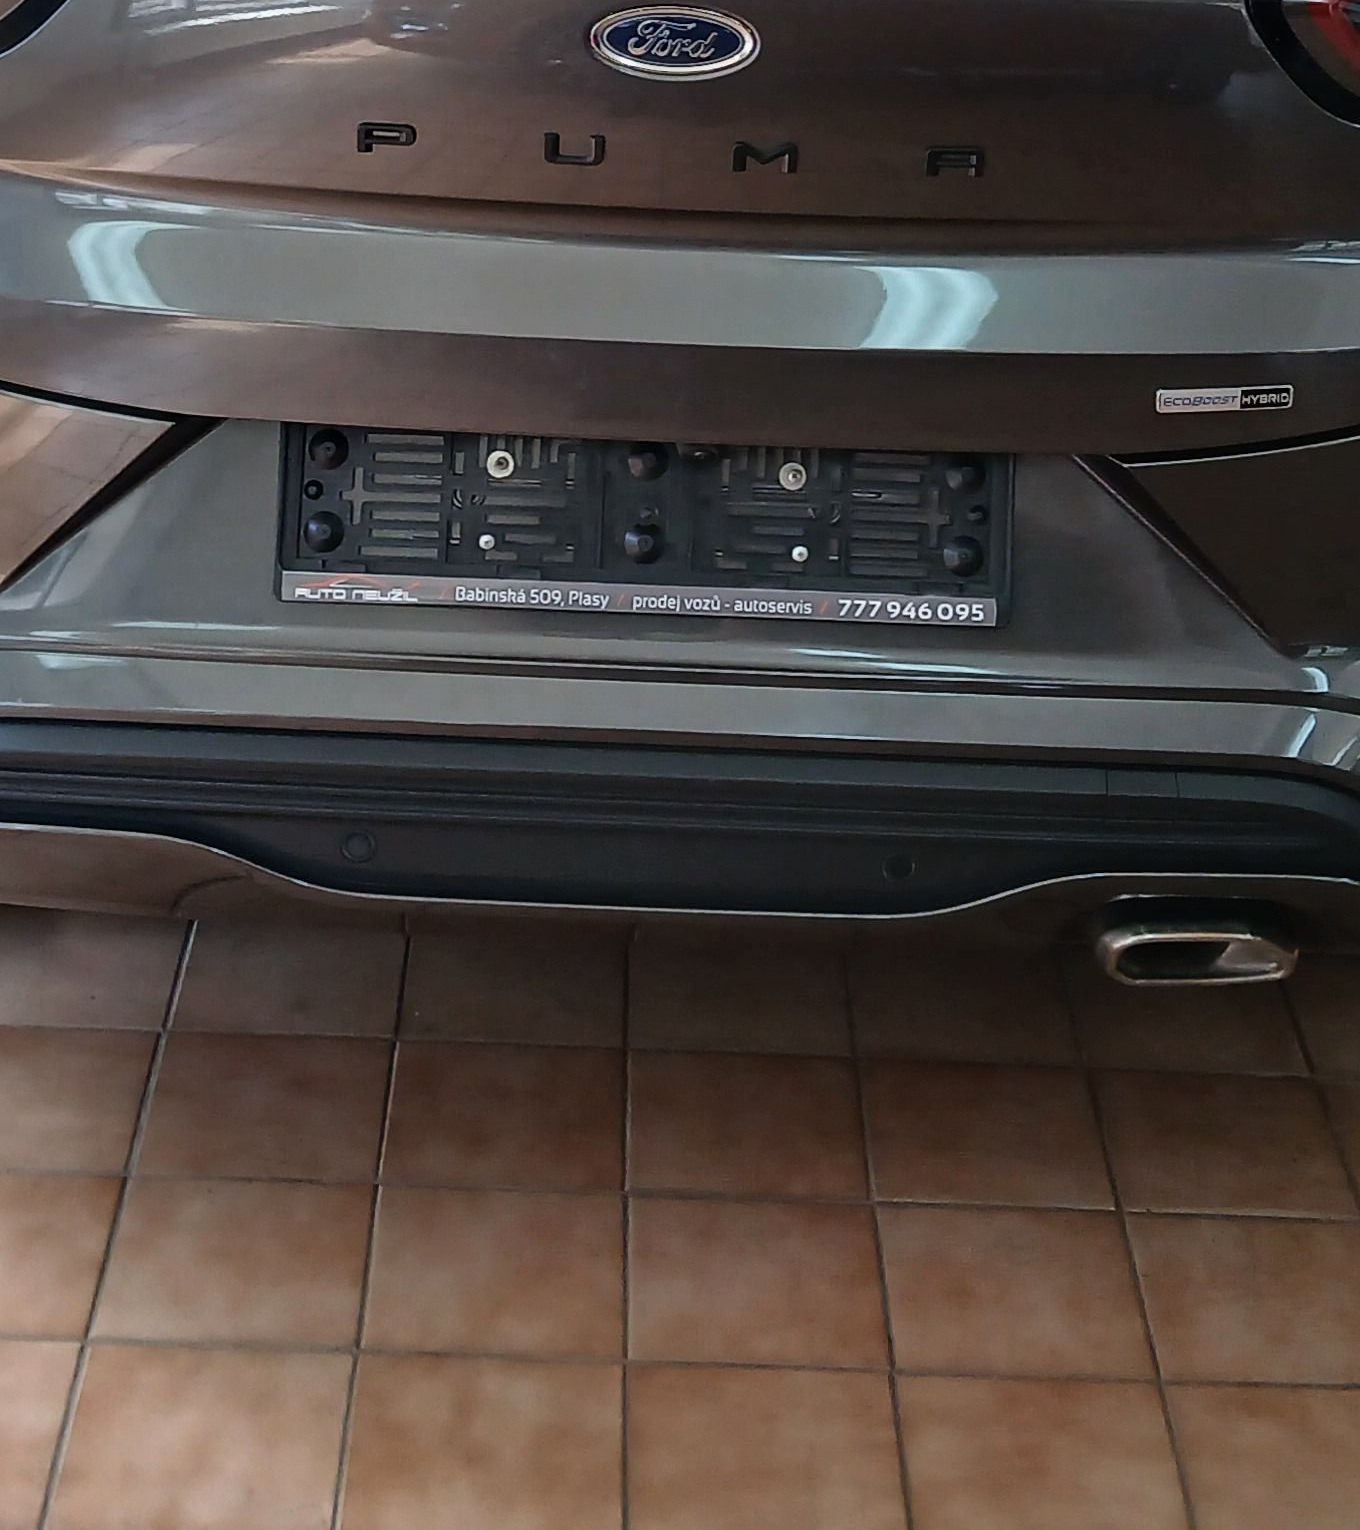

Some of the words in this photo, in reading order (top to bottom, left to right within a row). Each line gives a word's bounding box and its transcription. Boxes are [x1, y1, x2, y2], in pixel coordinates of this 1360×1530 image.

[627, 19, 719, 58] Ford
[357, 121, 986, 177] PUMA
[1241, 393, 1289, 405] HYBRID
[294, 587, 346, 600] AUTO
[455, 586, 526, 604] Babinská
[529, 590, 565, 607] 509,
[568, 590, 609, 609] Plasy
[632, 594, 680, 612] prodej
[684, 595, 720, 611] vozů
[733, 597, 812, 615] autoservis
[838, 599, 879, 617] 777
[886, 601, 932, 620] 946
[937, 602, 985, 621] 095
